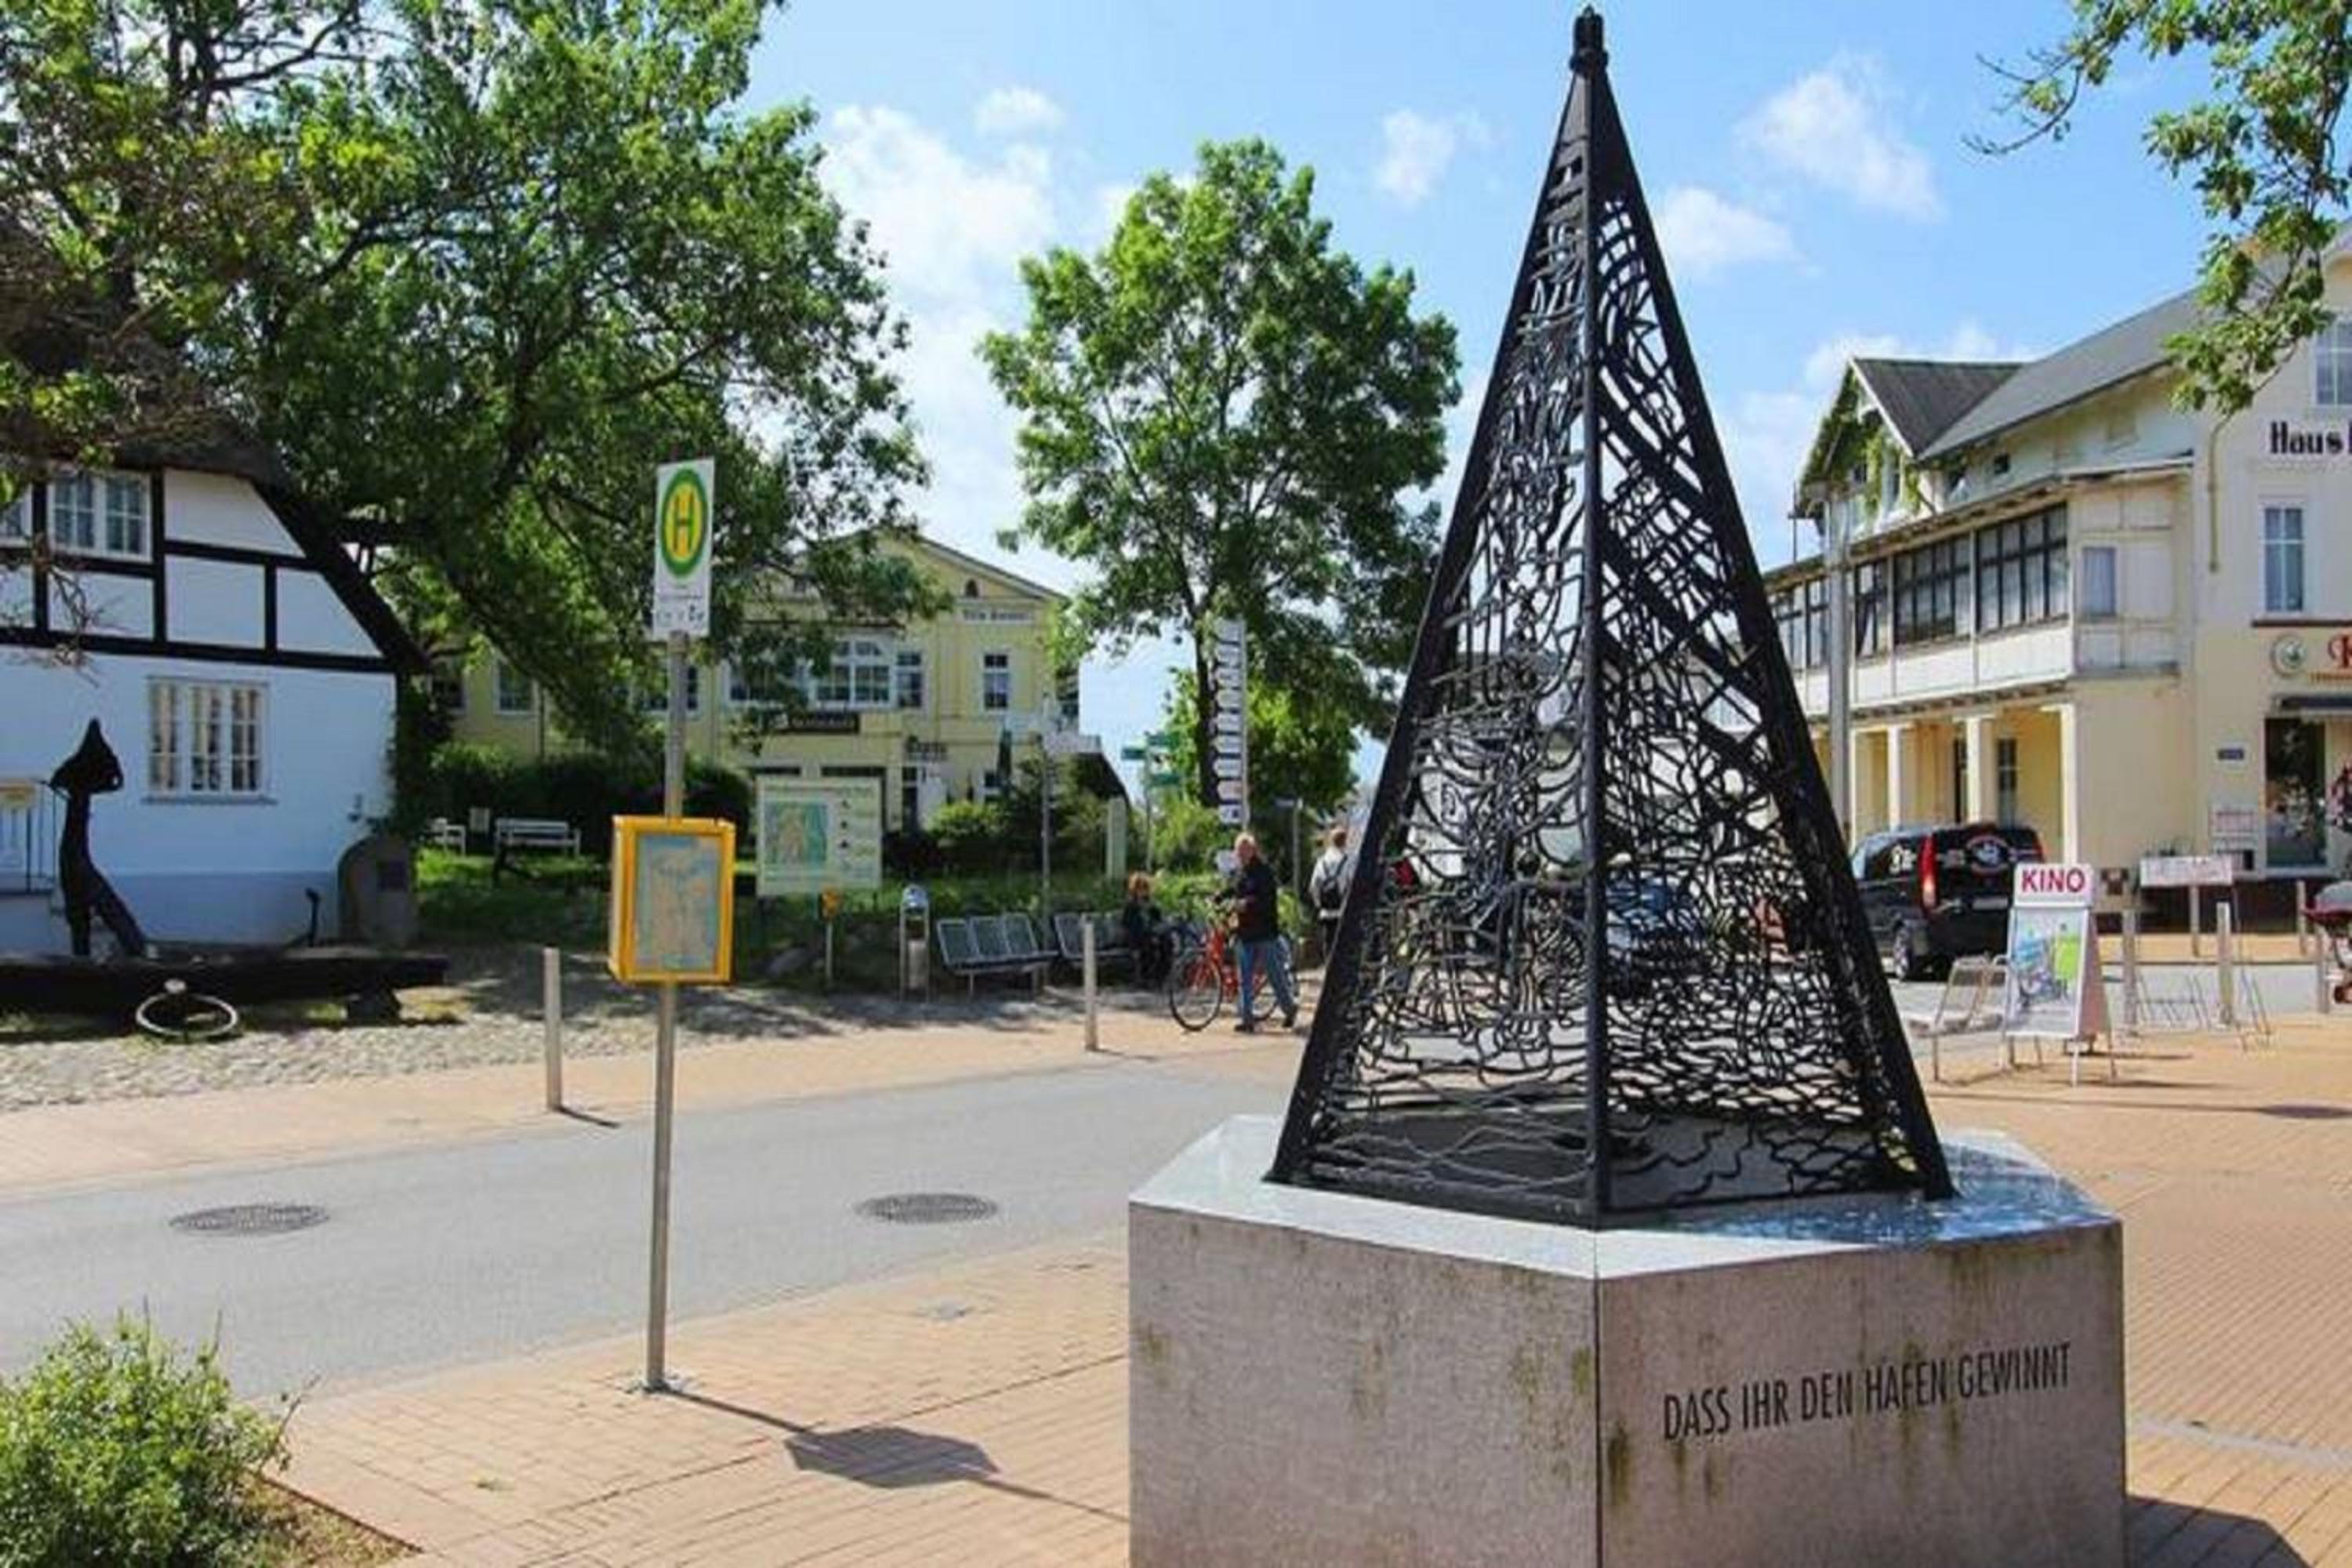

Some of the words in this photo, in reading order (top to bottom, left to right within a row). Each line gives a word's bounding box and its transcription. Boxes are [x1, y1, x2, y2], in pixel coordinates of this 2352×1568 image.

[2270, 421, 2343, 454] Haus
[673, 489, 695, 554] H
[2022, 867, 2085, 893] KINO
[1664, 1386, 1730, 1439] DASS
[1742, 1379, 1789, 1430] IHR
[1801, 1372, 1853, 1421] DEN
[1865, 1358, 1947, 1412] HAFEN
[1958, 1341, 2070, 1399] GEWINNT
